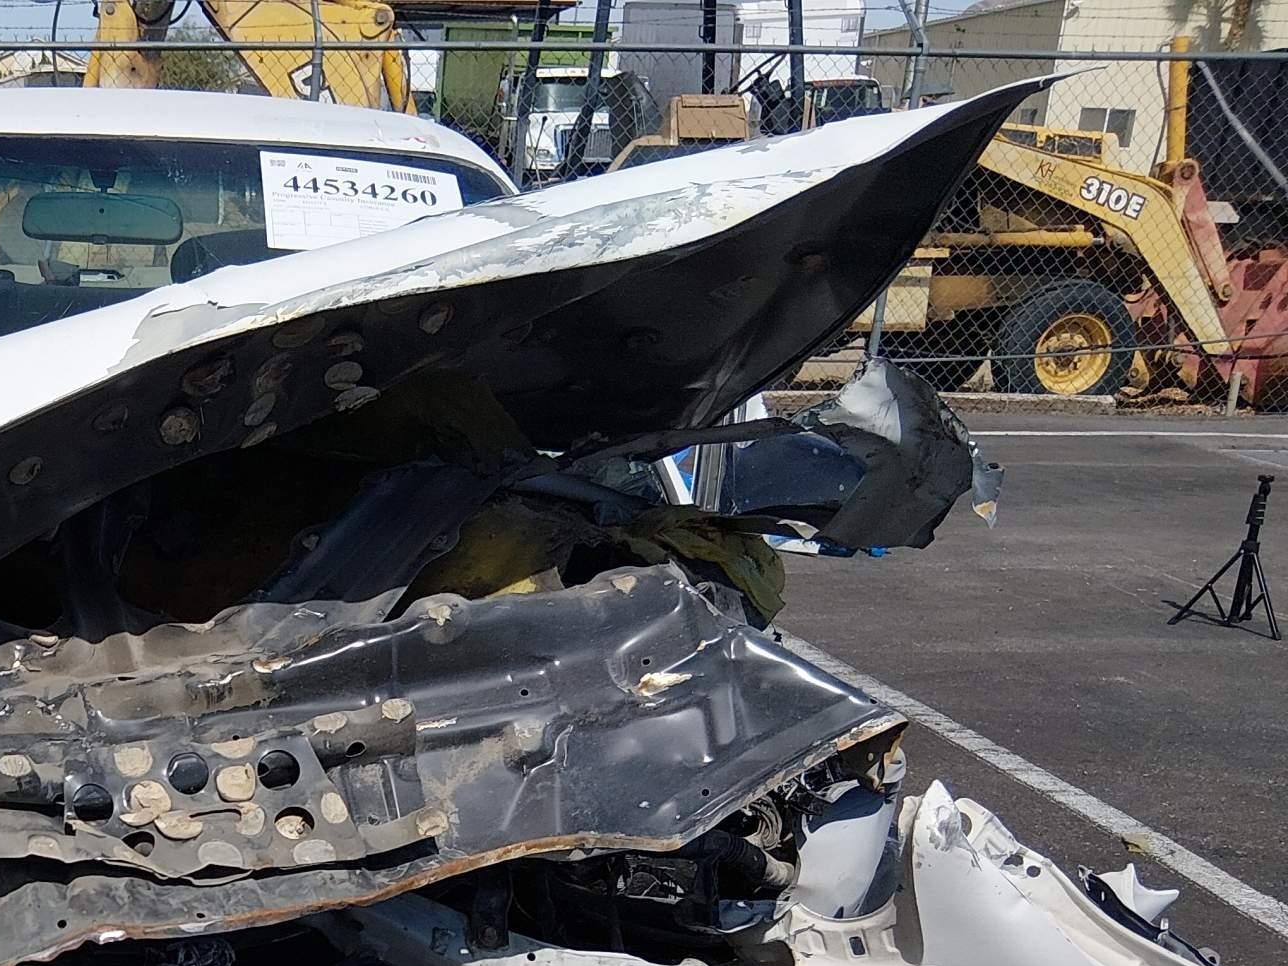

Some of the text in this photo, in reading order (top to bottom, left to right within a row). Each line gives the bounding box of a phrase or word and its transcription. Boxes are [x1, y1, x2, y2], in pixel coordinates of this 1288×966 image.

[1034, 160, 1057, 179] KH
[283, 175, 437, 206] 44534260
[1080, 176, 1147, 220] 310E
